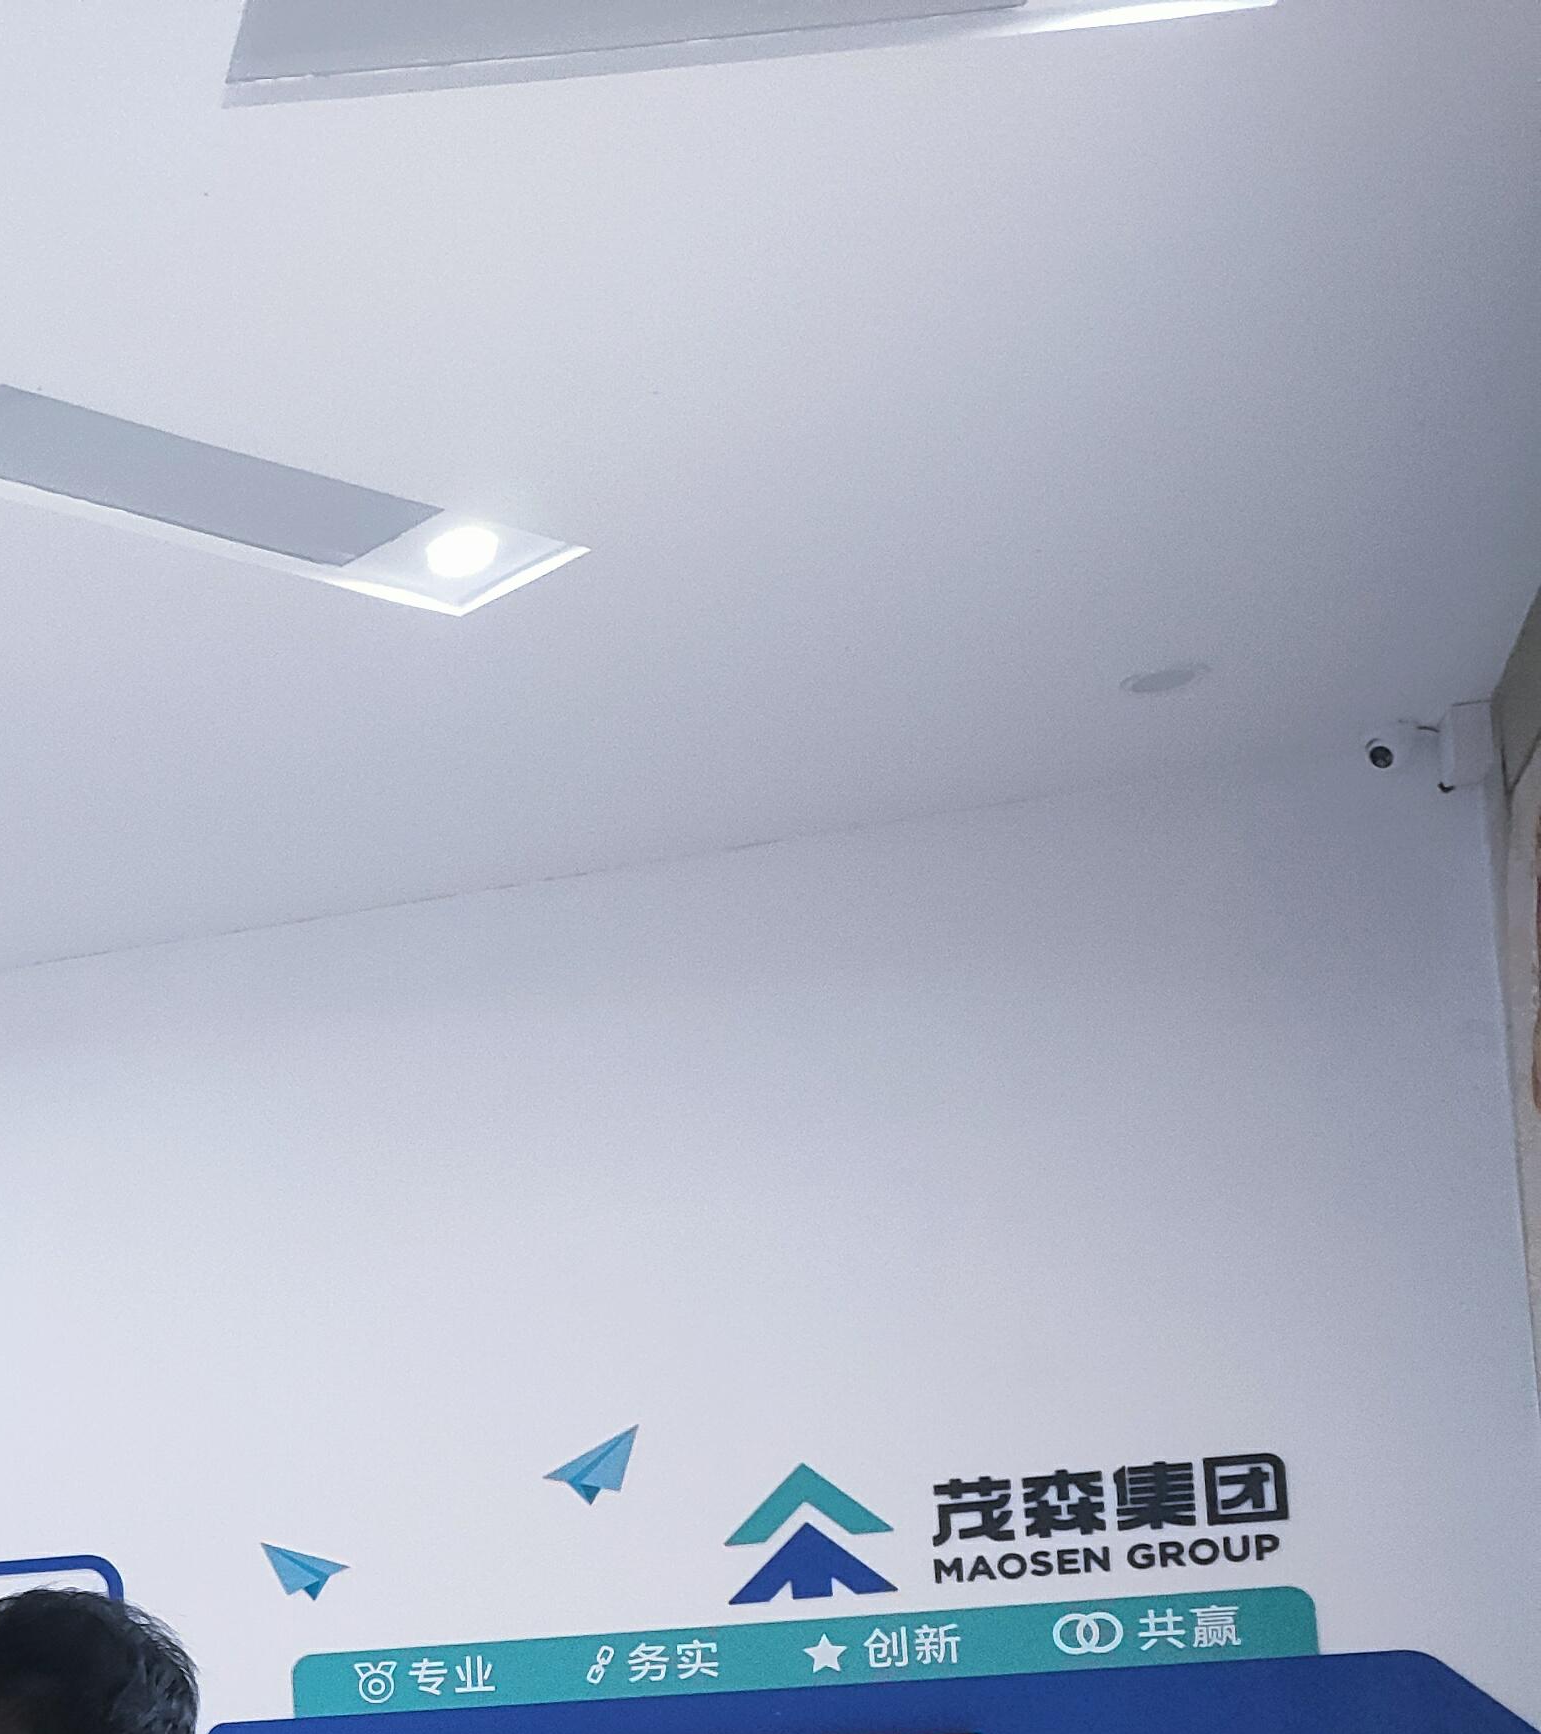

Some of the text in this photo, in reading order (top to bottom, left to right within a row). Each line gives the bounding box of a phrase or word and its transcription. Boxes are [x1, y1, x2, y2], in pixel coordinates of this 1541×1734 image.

[932, 1452, 1290, 1548] 茂森集团
[934, 1533, 1280, 1583] MAOSEN GROUP
[408, 1605, 1242, 1697] 专业 务实 创新 共赢
